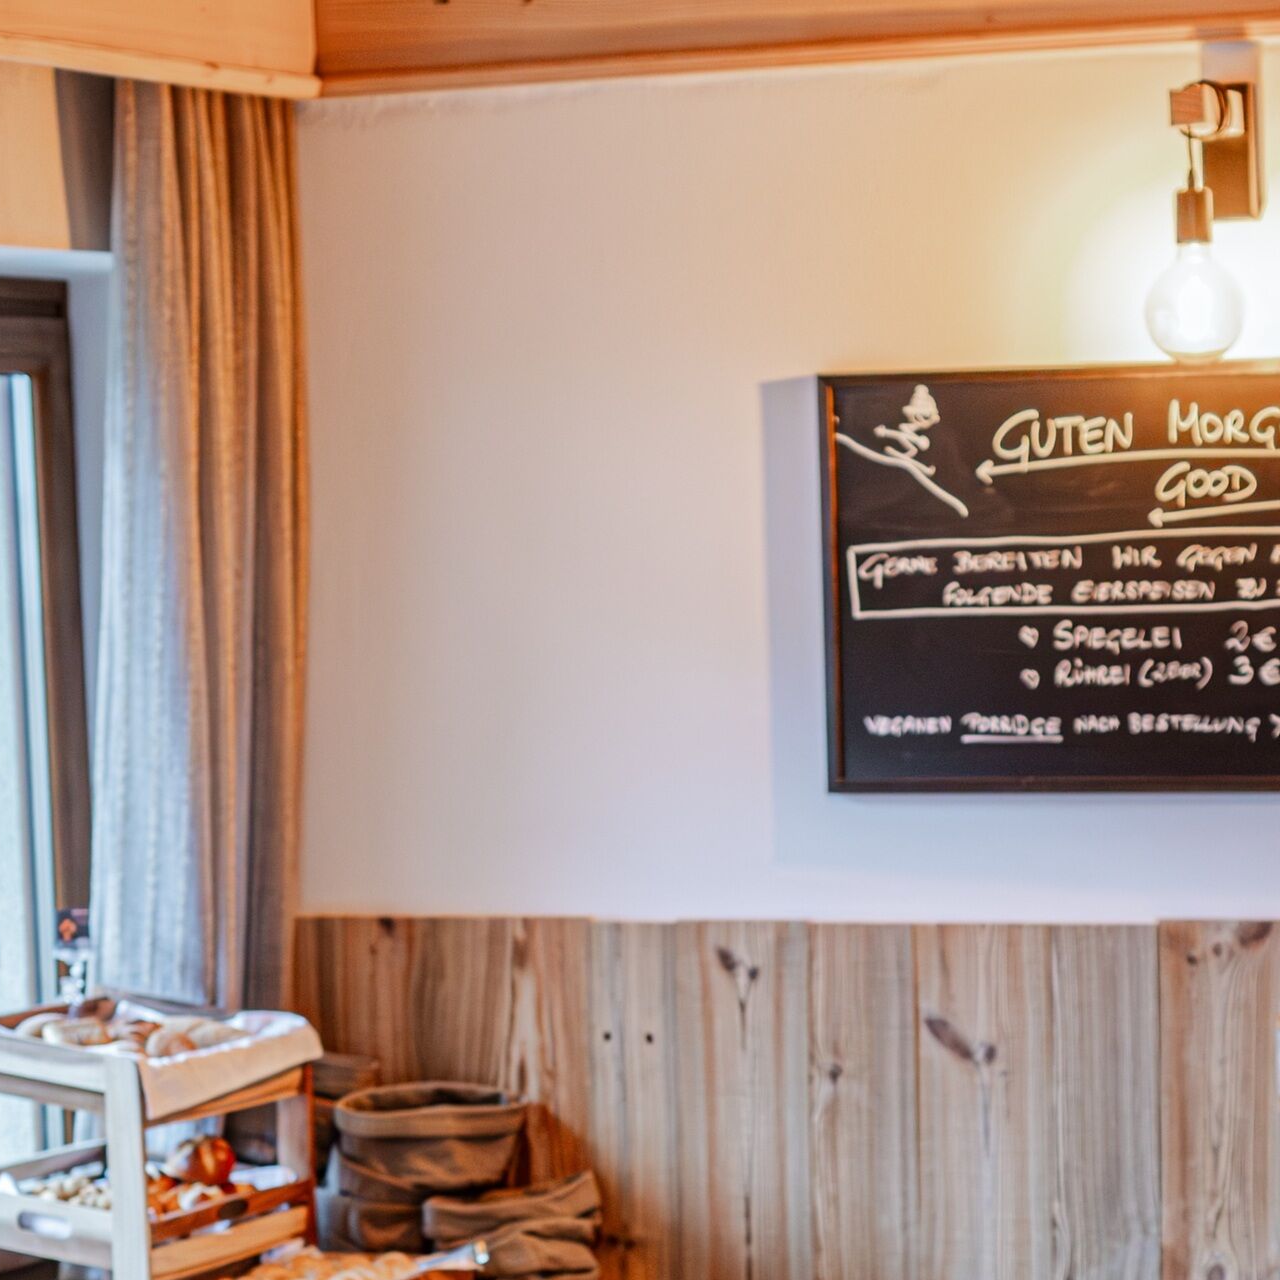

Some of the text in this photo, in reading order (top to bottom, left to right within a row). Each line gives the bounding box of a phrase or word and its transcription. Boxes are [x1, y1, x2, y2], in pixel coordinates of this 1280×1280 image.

[992, 408, 1133, 466] GUTEN
[1154, 461, 1257, 508] GOOD
[952, 546, 1083, 575] BEREITEN
[1111, 544, 1162, 569] WIR
[1175, 542, 1258, 573] GEGEN
[942, 581, 1054, 607] FOLGENDE
[1071, 579, 1216, 604] EIERSPEISEN
[1052, 619, 1183, 655] SPIEGELEI
[960, 712, 1063, 737] PORRIDGE
[1127, 711, 1261, 743] BESTELLUNG
